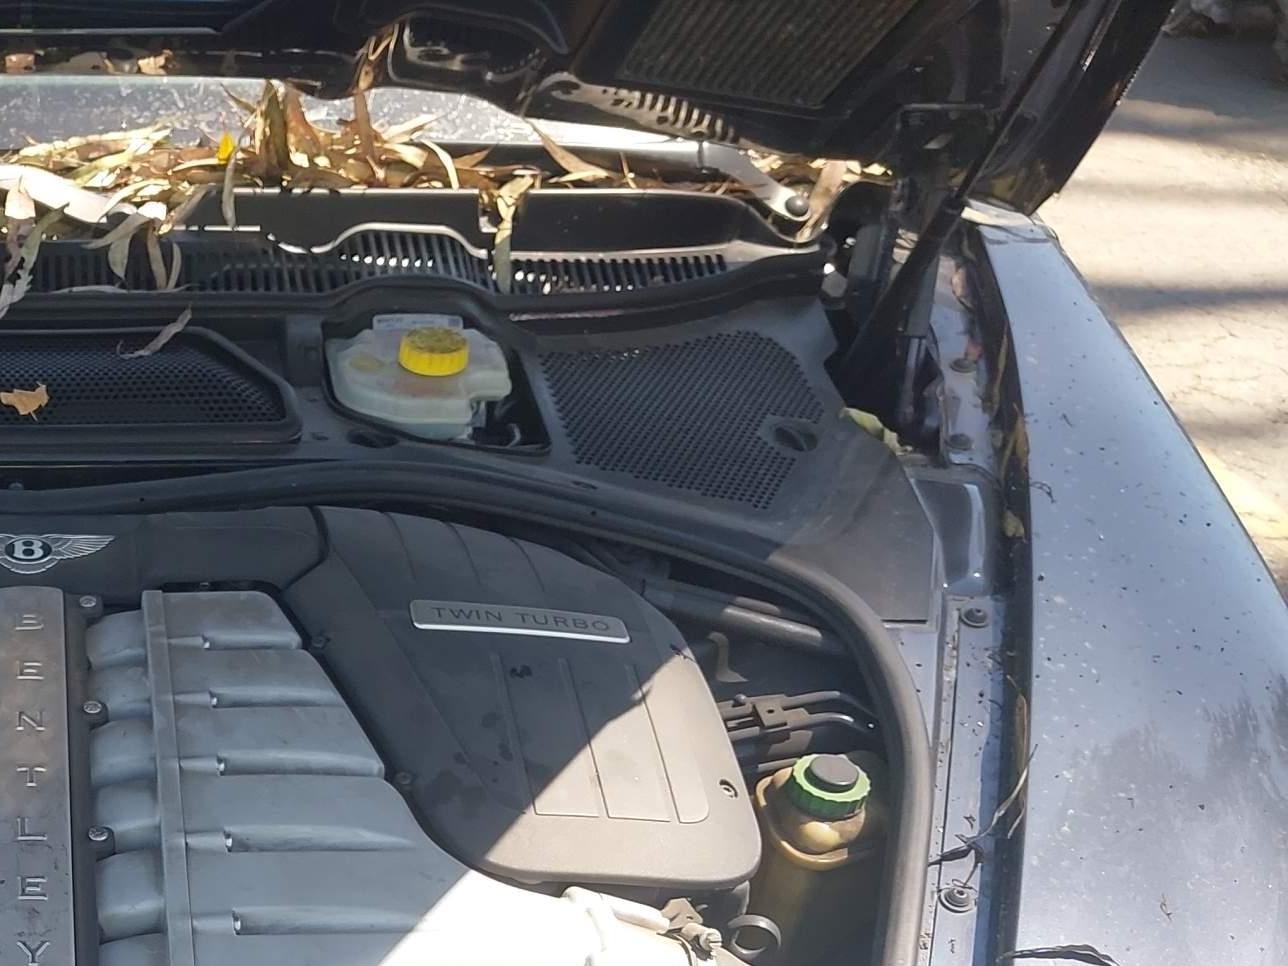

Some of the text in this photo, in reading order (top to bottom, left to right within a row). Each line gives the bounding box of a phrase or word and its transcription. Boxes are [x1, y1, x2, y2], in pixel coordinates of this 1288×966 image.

[431, 607, 610, 632] TWIN TURBO
[15, 613, 50, 966] BENTLEY
